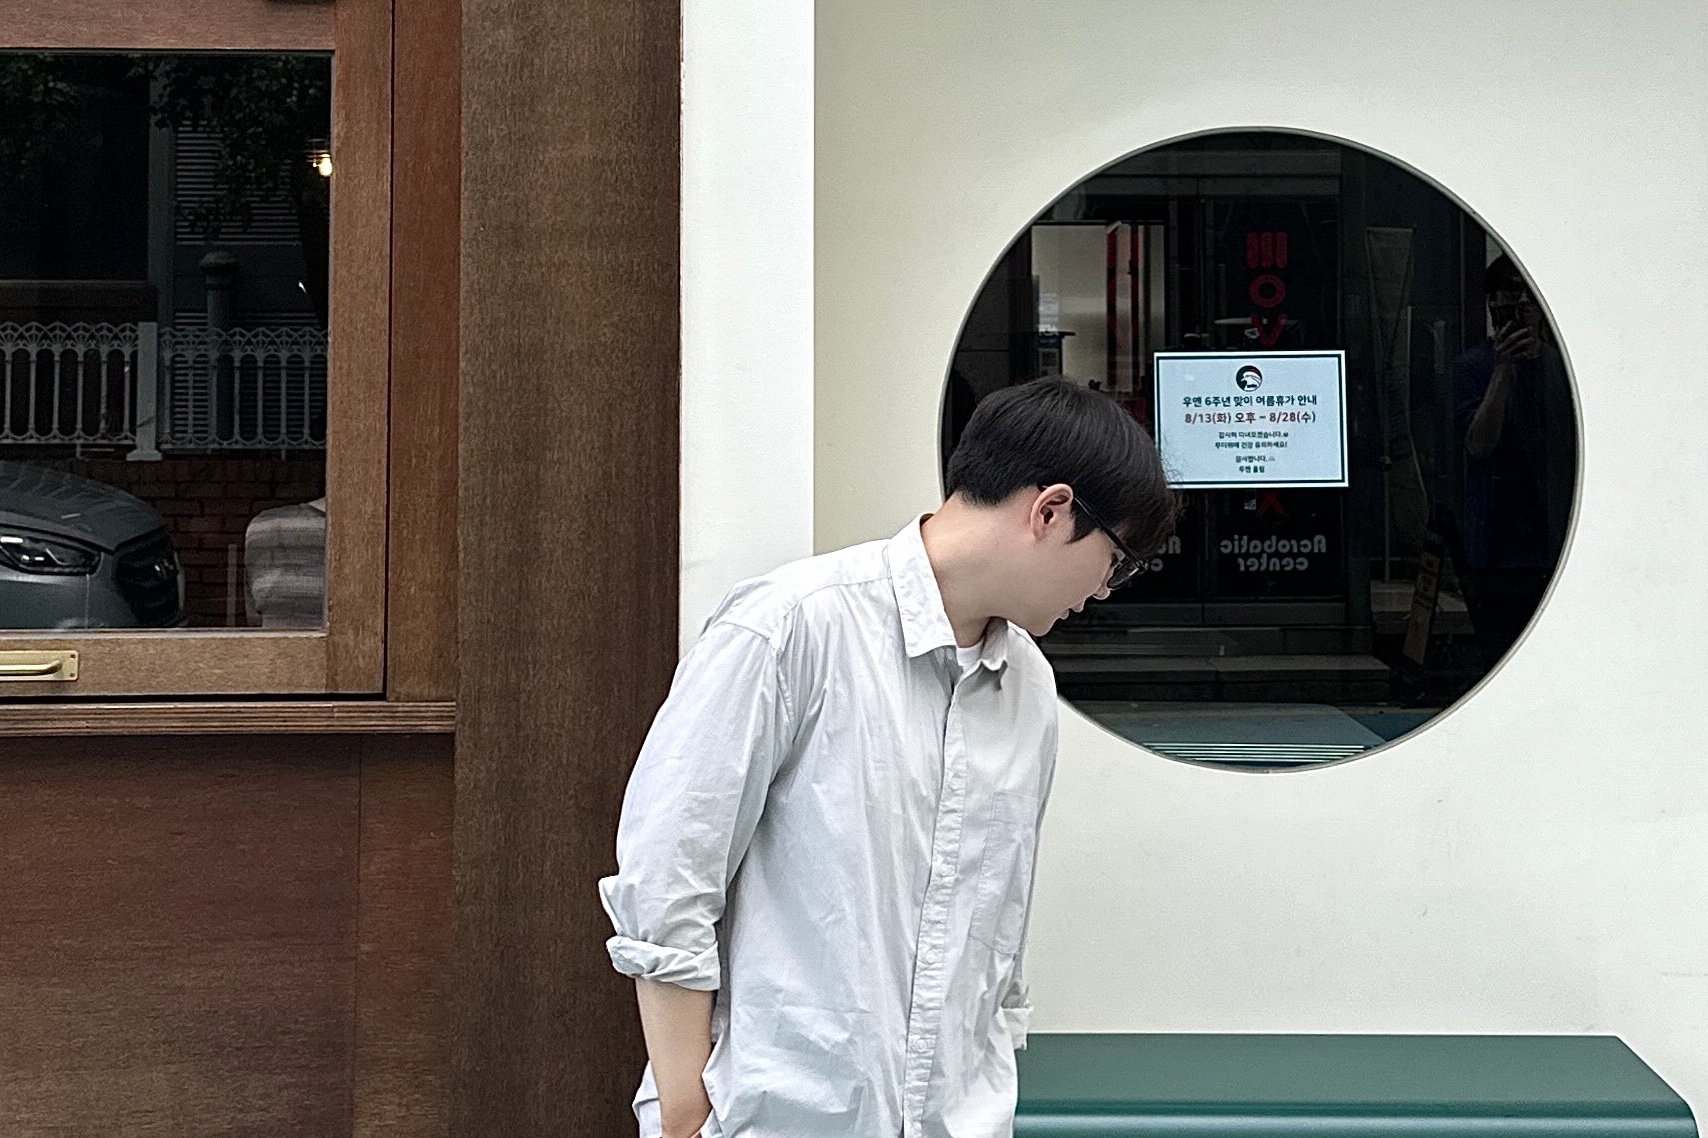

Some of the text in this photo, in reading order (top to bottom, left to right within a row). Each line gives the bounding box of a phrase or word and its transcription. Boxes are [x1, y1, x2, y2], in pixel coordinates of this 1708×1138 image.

[1205, 396, 1231, 407] 6주년
[1233, 396, 1253, 407] 맞이
[1256, 395, 1295, 407] 여름휴가
[1297, 394, 1317, 406] 안내
[1185, 412, 1231, 424] 8/13(화)
[1234, 412, 1256, 424] 오후
[1269, 411, 1316, 424] 8/28(수)
